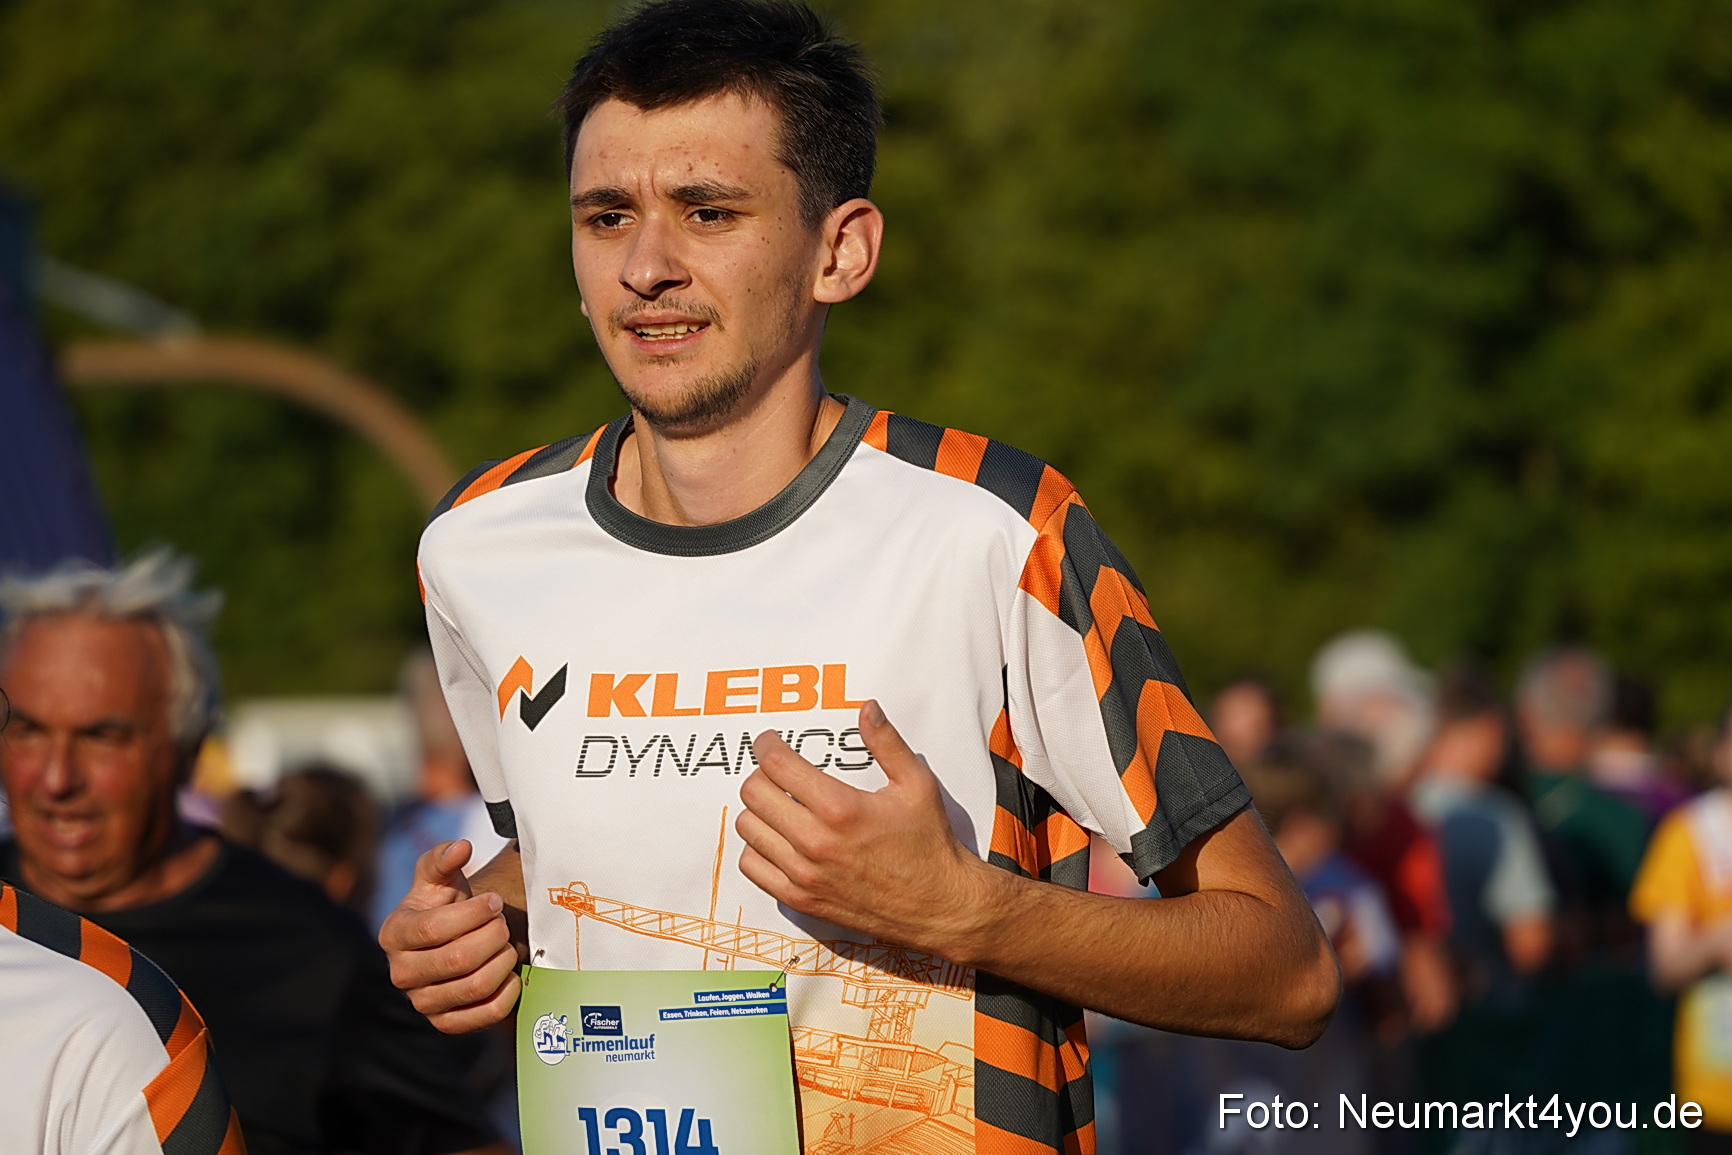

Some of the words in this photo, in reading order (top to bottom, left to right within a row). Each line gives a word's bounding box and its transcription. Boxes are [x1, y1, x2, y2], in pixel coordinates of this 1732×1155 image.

[586, 664, 866, 718] KLEBL
[697, 994, 721, 1003] Laufen,
[721, 993, 746, 1002] Joggen,
[745, 991, 770, 999] Walken
[662, 1011, 684, 1019] Essen,
[683, 1009, 709, 1018] Trinken,
[709, 1008, 731, 1016] Feiern,
[730, 1006, 768, 1015] Netzwerken
[590, 1018, 620, 1026] Fischer
[572, 1033, 655, 1053] Firmenlauf
[605, 1050, 656, 1062] neumarkt
[577, 1107, 720, 1155] 1314
